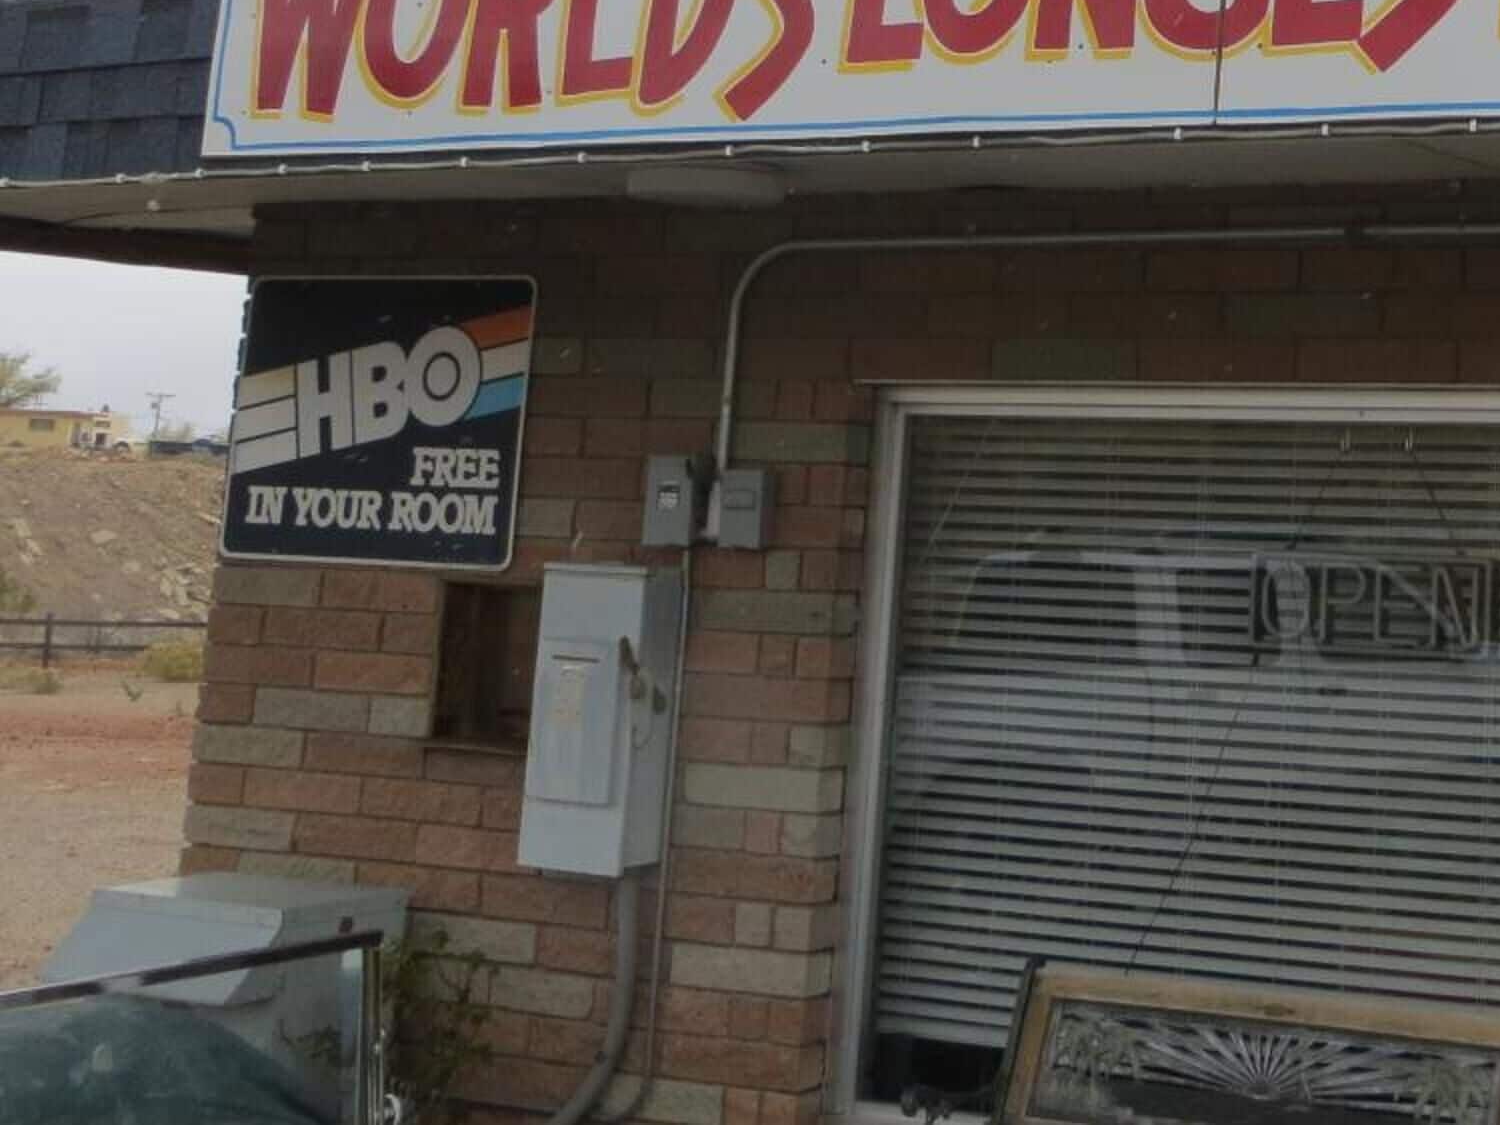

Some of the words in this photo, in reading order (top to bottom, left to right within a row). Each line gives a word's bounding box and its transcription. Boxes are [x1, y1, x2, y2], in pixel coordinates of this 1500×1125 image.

[297, 325, 482, 460] HBO
[410, 446, 501, 489] FREE
[245, 485, 286, 526] IN
[291, 486, 384, 530] YOUR
[388, 494, 497, 535] ROOM
[1262, 562, 1480, 649] OPEN
